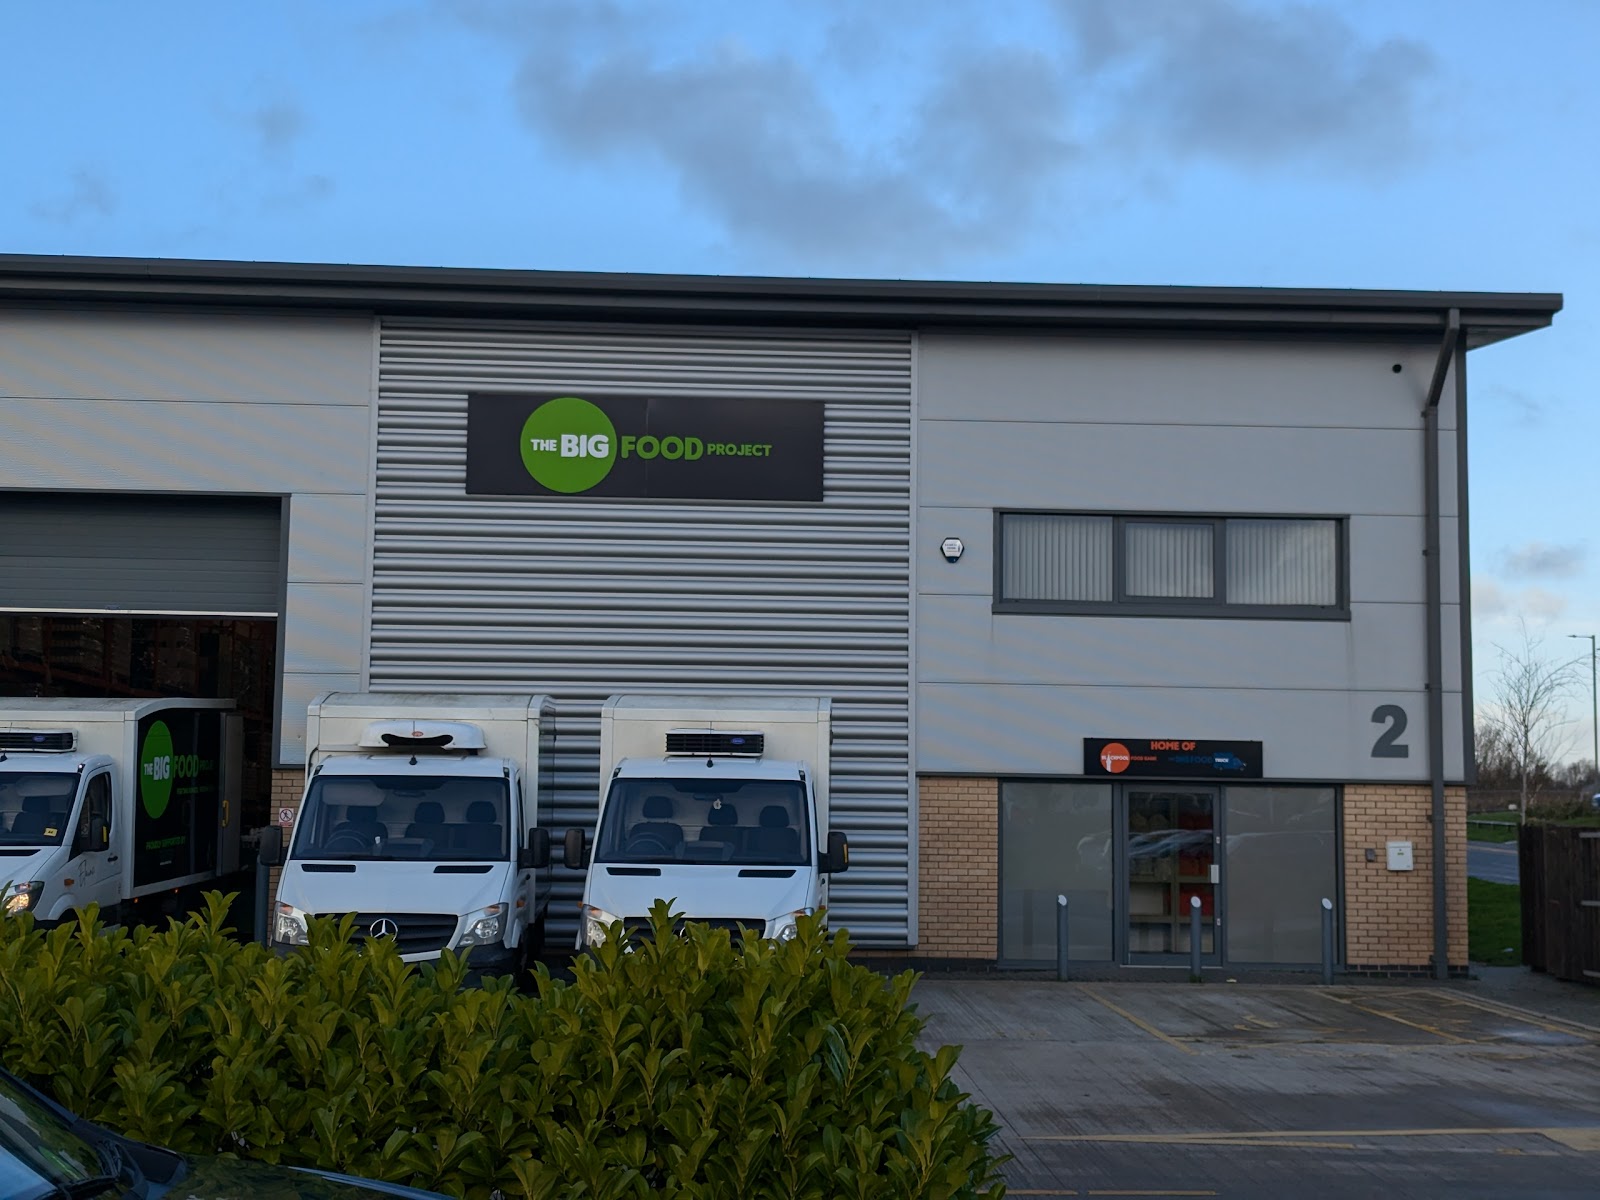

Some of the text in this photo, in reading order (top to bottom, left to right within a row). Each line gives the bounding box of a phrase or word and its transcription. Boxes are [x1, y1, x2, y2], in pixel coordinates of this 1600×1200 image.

[531, 433, 773, 461] THE BIG FOOD PROJECT
[1371, 704, 1409, 758] 2
[1150, 741, 1196, 751] HOME OF
[143, 762, 153, 776] THE
[153, 755, 171, 781] BIG
[173, 754, 199, 779] FOOD
